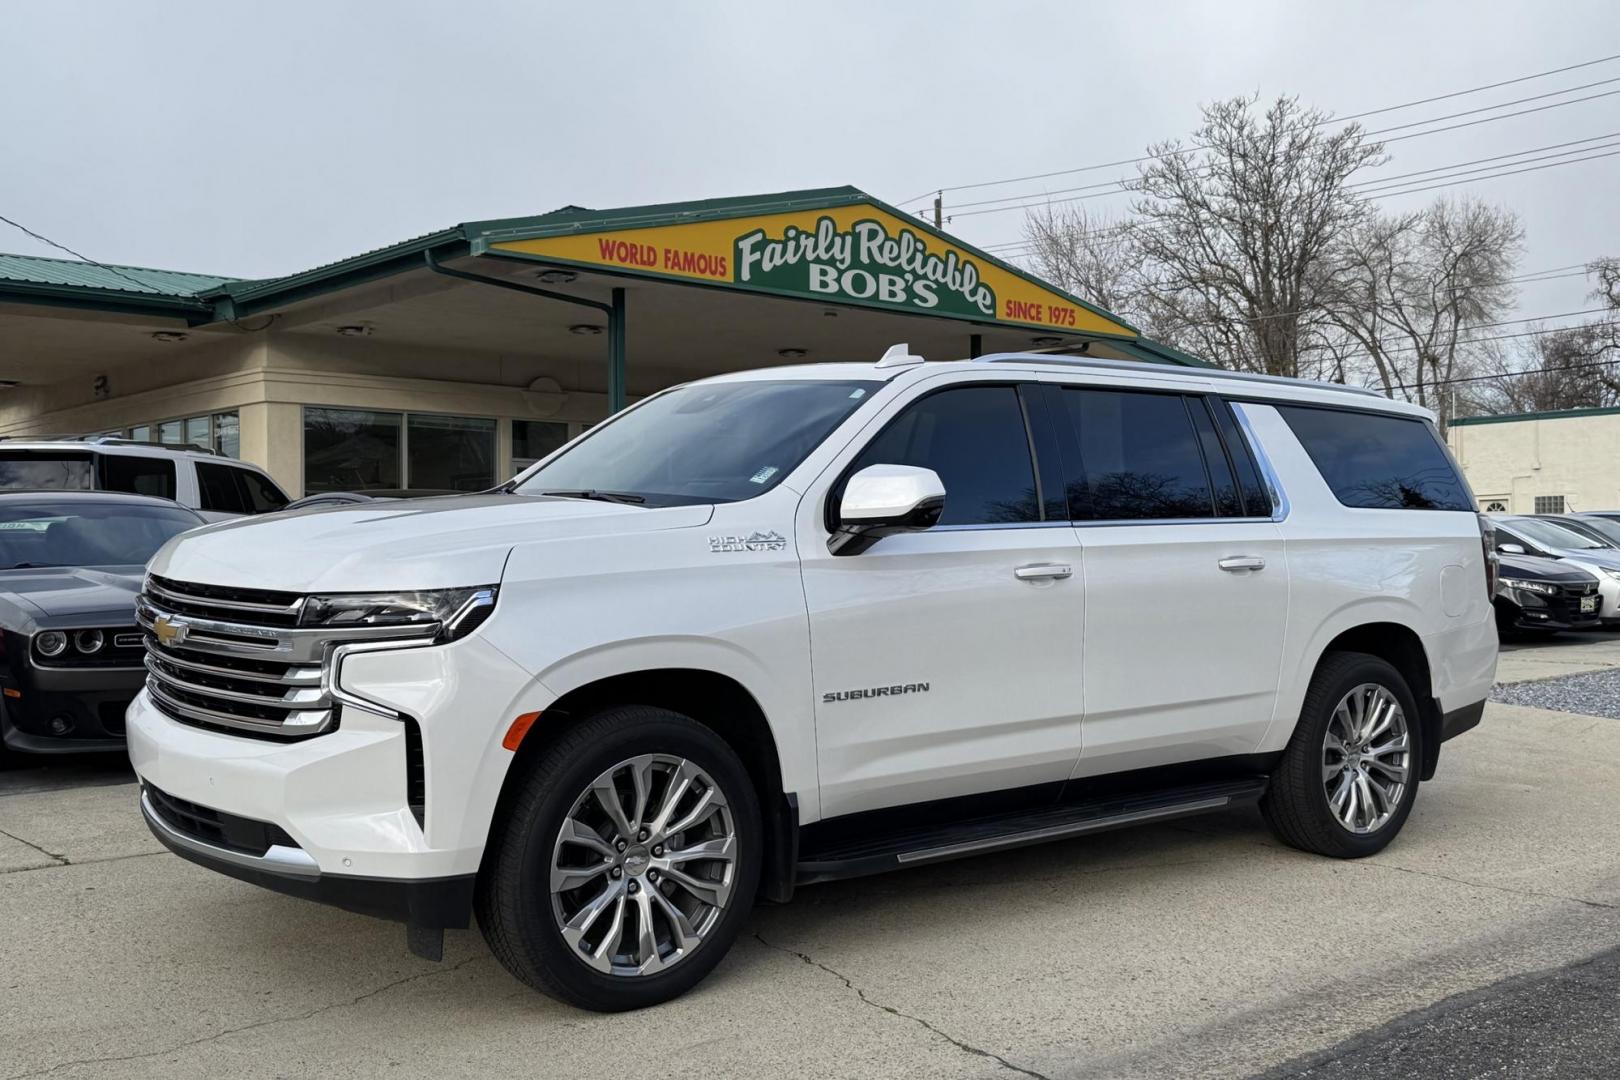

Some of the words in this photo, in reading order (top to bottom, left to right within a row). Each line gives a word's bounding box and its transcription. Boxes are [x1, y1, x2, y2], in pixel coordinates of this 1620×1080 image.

[598, 238, 657, 267] WORLD
[664, 248, 727, 277] FAMOUS
[738, 219, 852, 282] Fairly
[855, 221, 994, 314] Reliable
[809, 263, 939, 308] BOB'S
[1006, 299, 1042, 322] SINCE
[1048, 306, 1076, 326] 1975
[709, 542, 787, 553] COUNTRY
[823, 682, 930, 703] SUBURBAN
